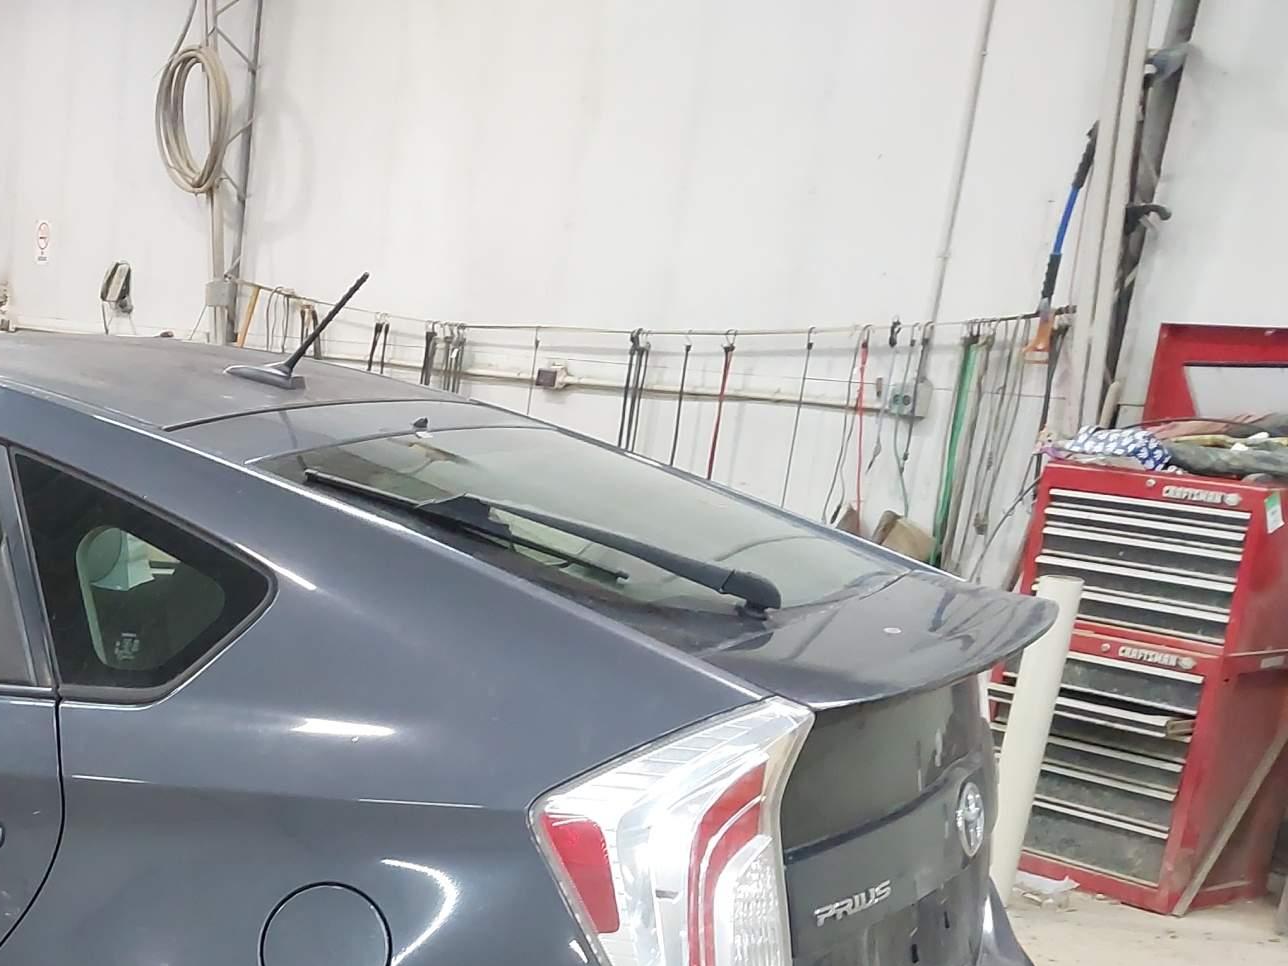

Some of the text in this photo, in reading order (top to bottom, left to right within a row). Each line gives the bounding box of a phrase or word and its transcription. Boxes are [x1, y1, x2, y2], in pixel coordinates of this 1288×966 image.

[1162, 485, 1224, 503] CRAFTSMAN
[1118, 646, 1176, 666] CRAFTSMAN
[814, 880, 891, 926] PRIUS
